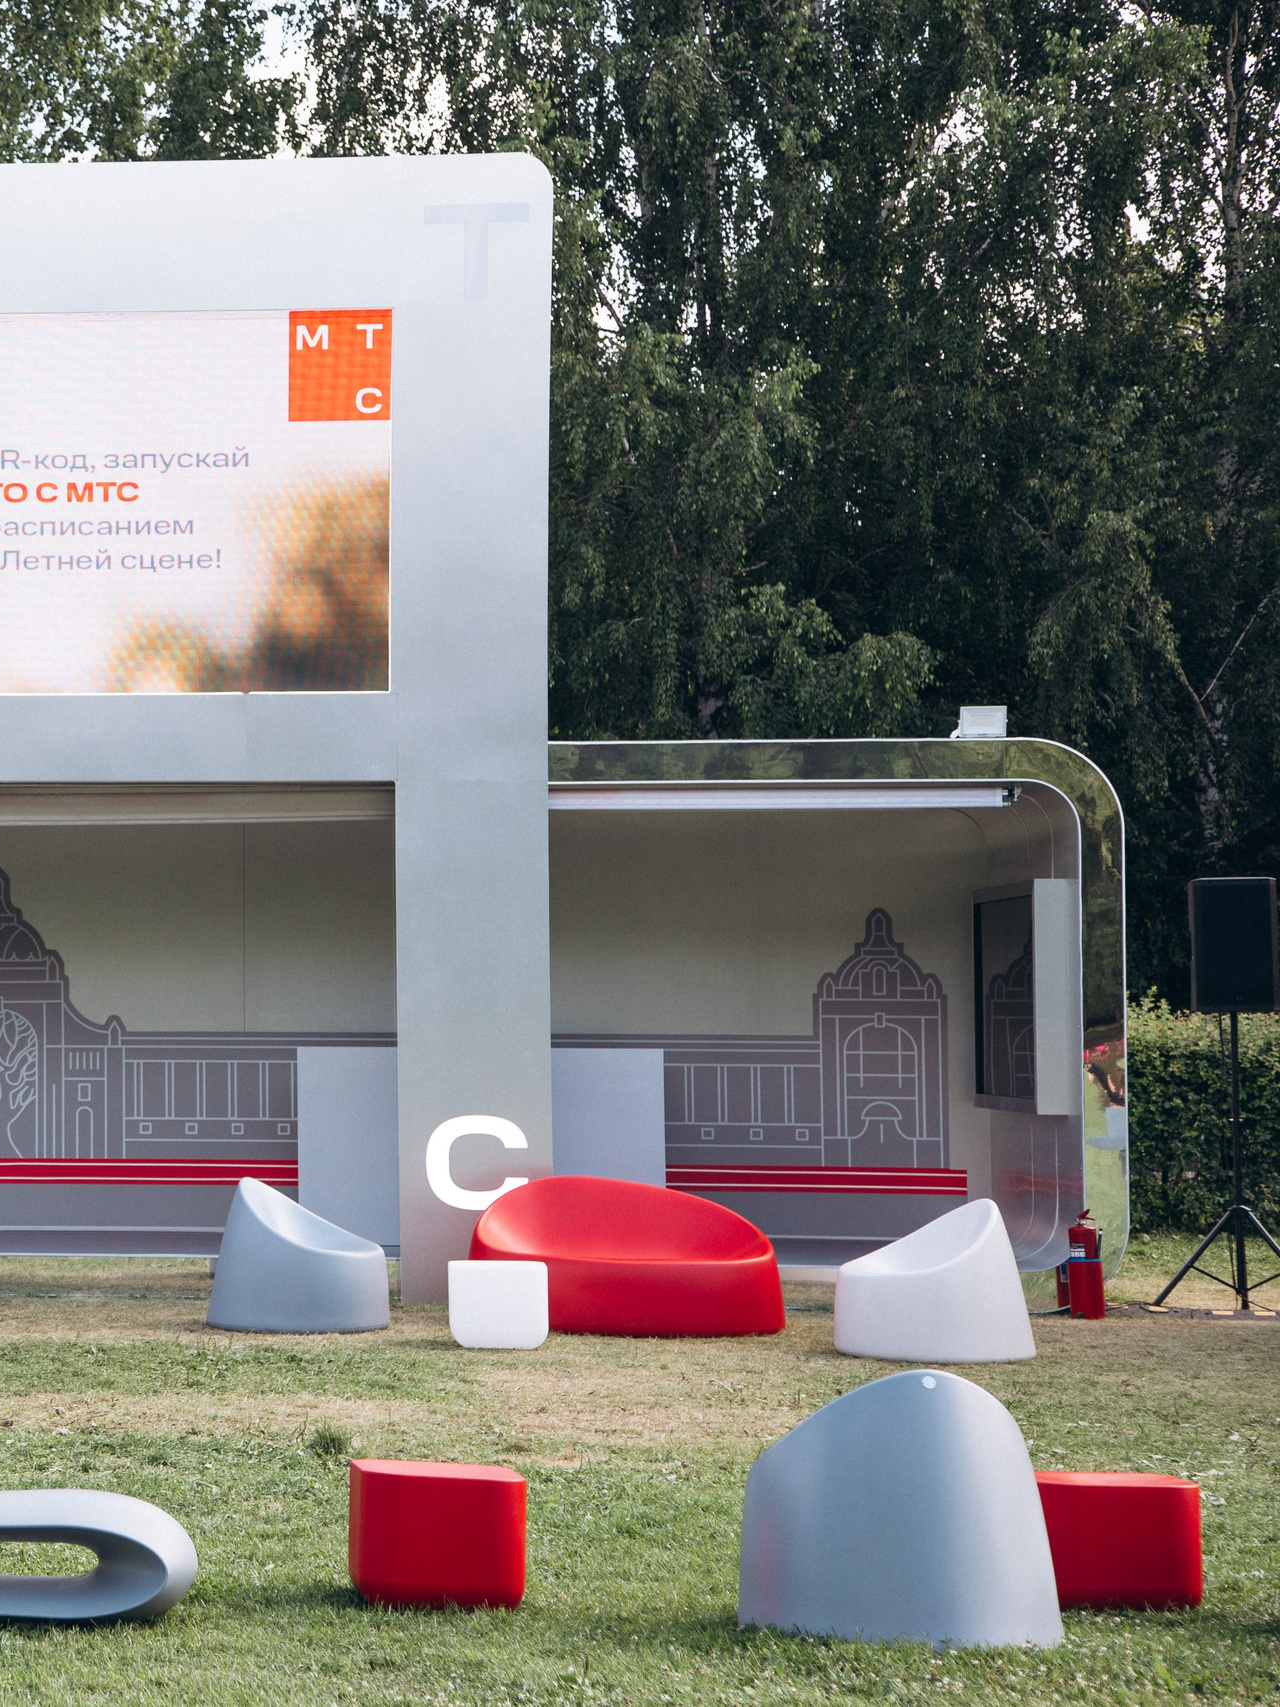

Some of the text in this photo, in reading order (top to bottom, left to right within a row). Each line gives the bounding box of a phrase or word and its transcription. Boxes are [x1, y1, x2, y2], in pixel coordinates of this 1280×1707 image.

[103, 446, 250, 474] запускай
[35, 482, 59, 503] С
[66, 481, 140, 503] МТС
[0, 548, 112, 571] Летней
[120, 548, 222, 573] сцене!
